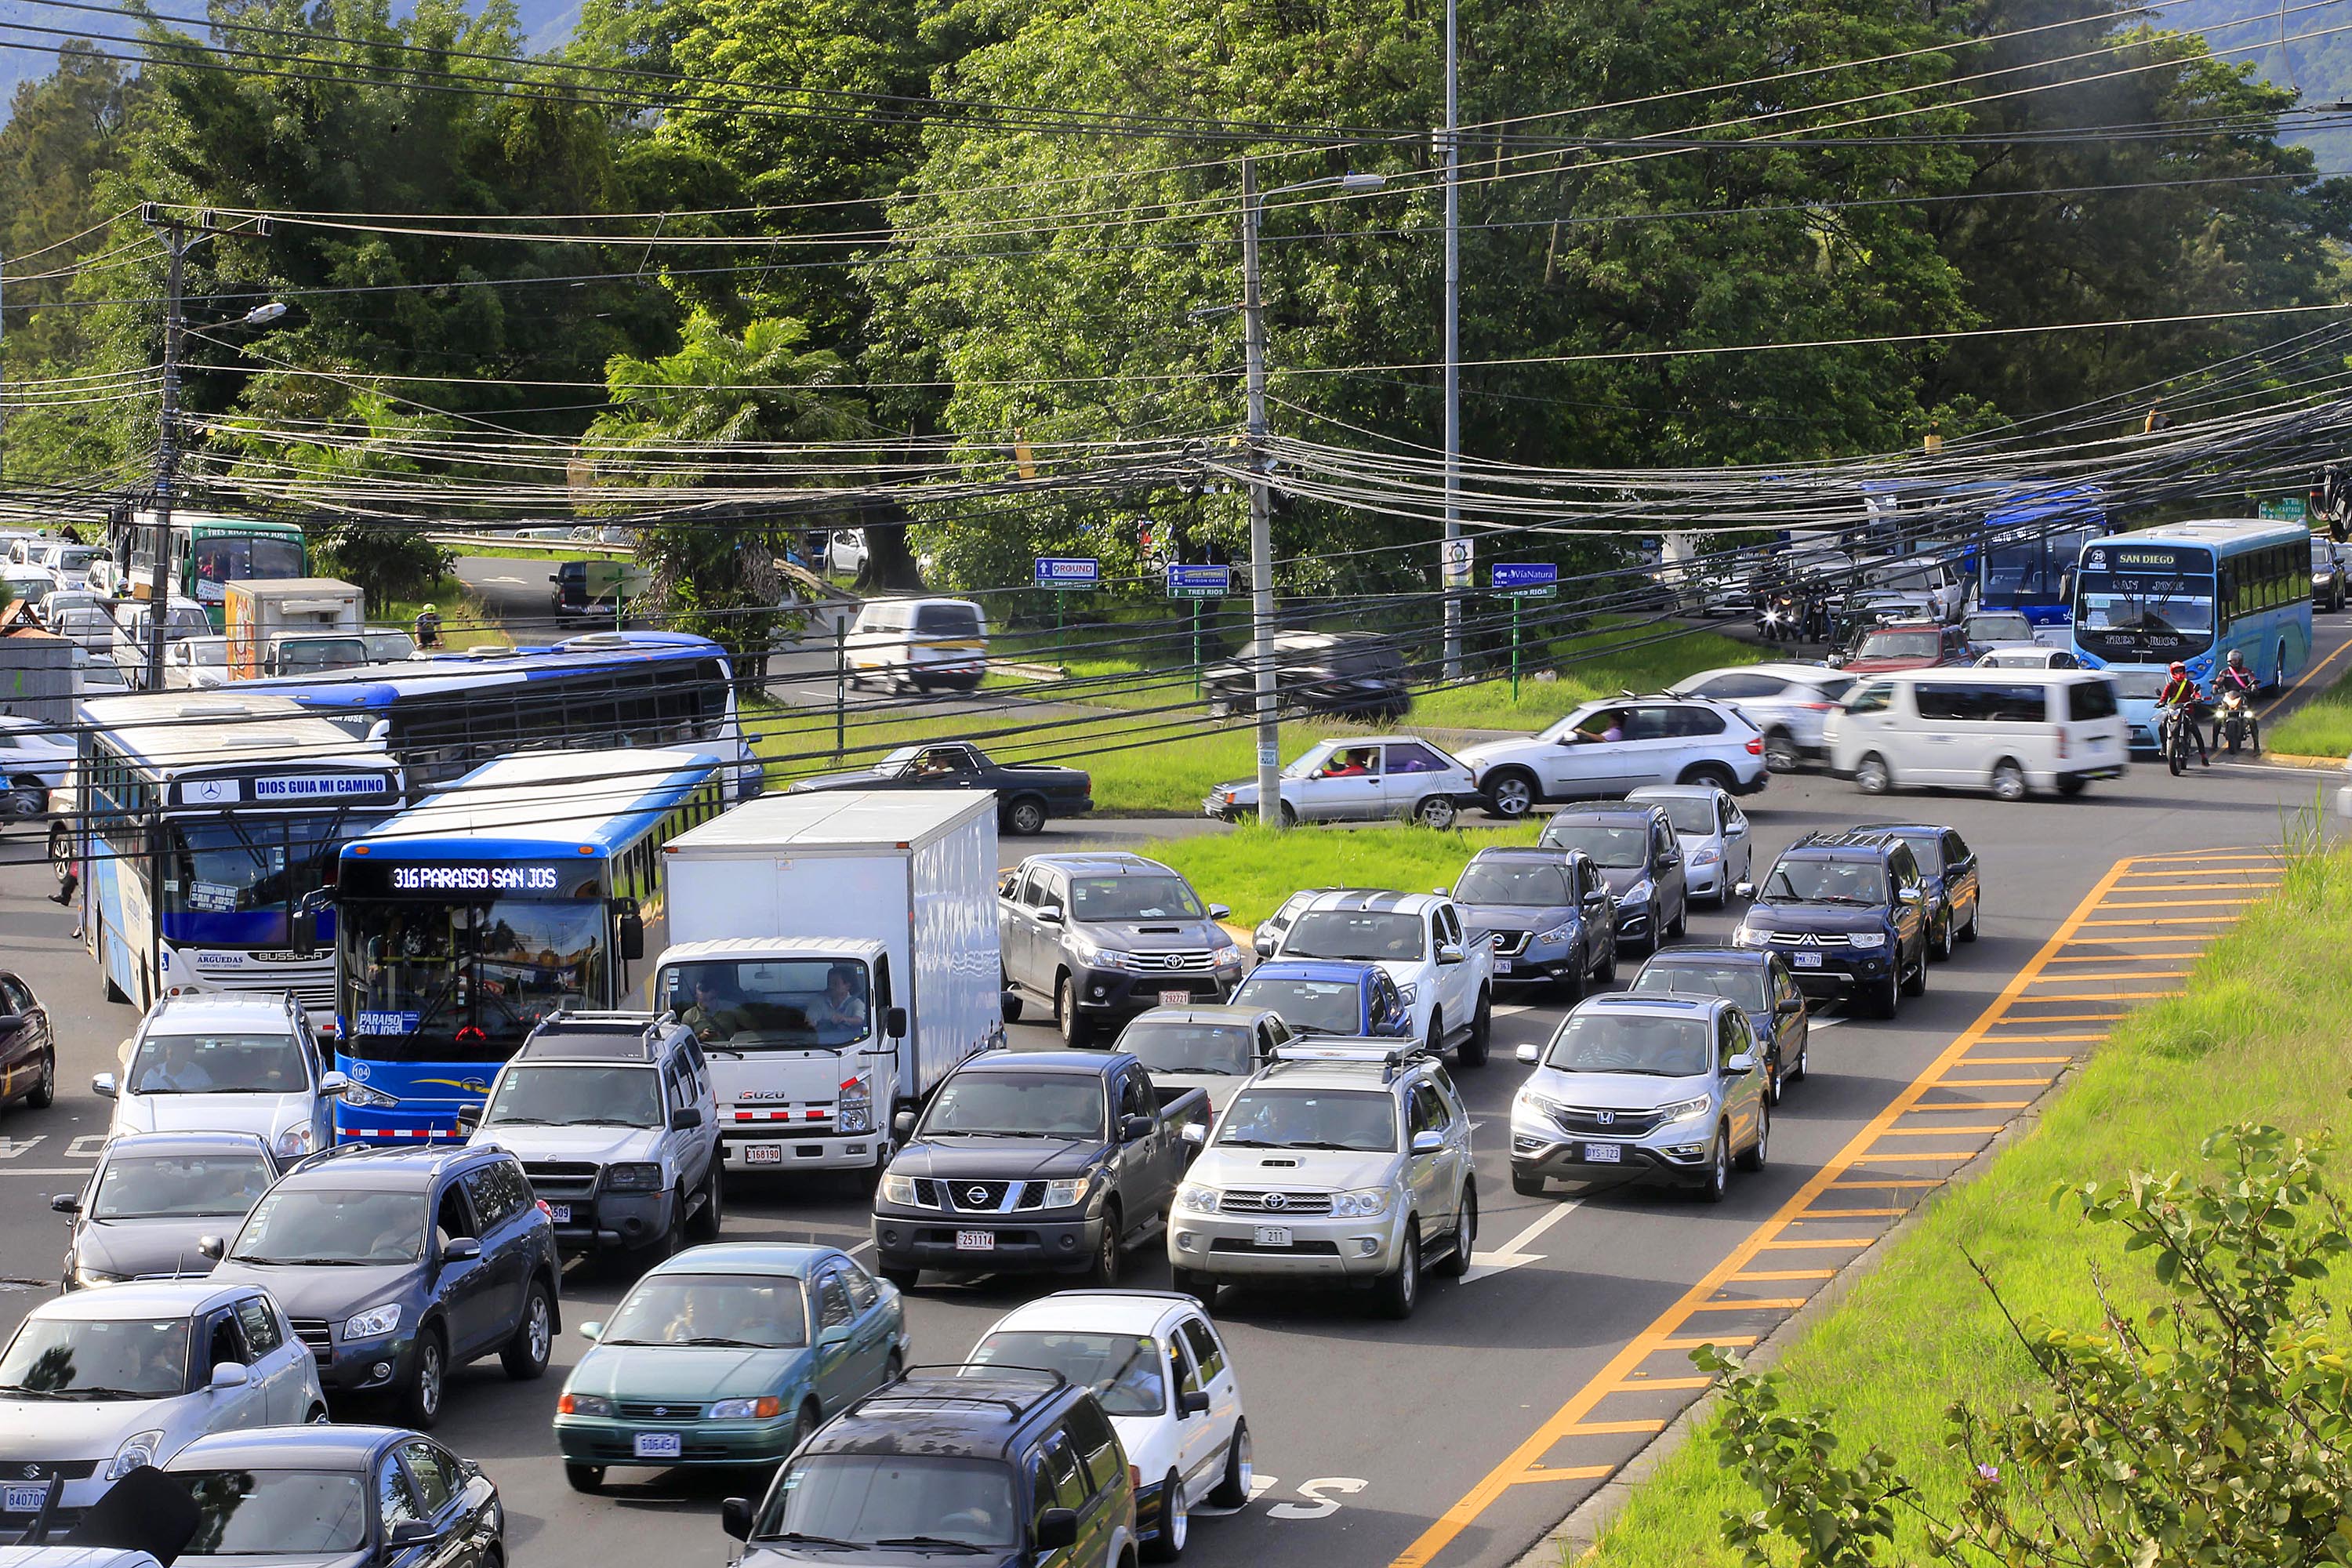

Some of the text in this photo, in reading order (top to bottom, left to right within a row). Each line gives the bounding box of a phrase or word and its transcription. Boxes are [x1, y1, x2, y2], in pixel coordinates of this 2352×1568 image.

[2119, 555, 2175, 564] SAN DIEGO
[1053, 565, 1092, 574] 9ROUND
[2105, 635, 2178, 647] TRES RIOS
[343, 714, 363, 723] JOSE
[257, 779, 383, 793] DIOS GUIA MI CAMINO
[394, 868, 557, 888] 316 PARAISO SAN JOS
[191, 893, 235, 906] SAN JOSE
[359, 1014, 401, 1025] PARAISO
[358, 1025, 378, 1035] SAN
[354, 1068, 368, 1076] 104
[739, 1091, 785, 1099] ISUZU
[963, 1235, 992, 1245] 251114
[1268, 1231, 1283, 1241] 211
[9, 1494, 45, 1506] 840700
